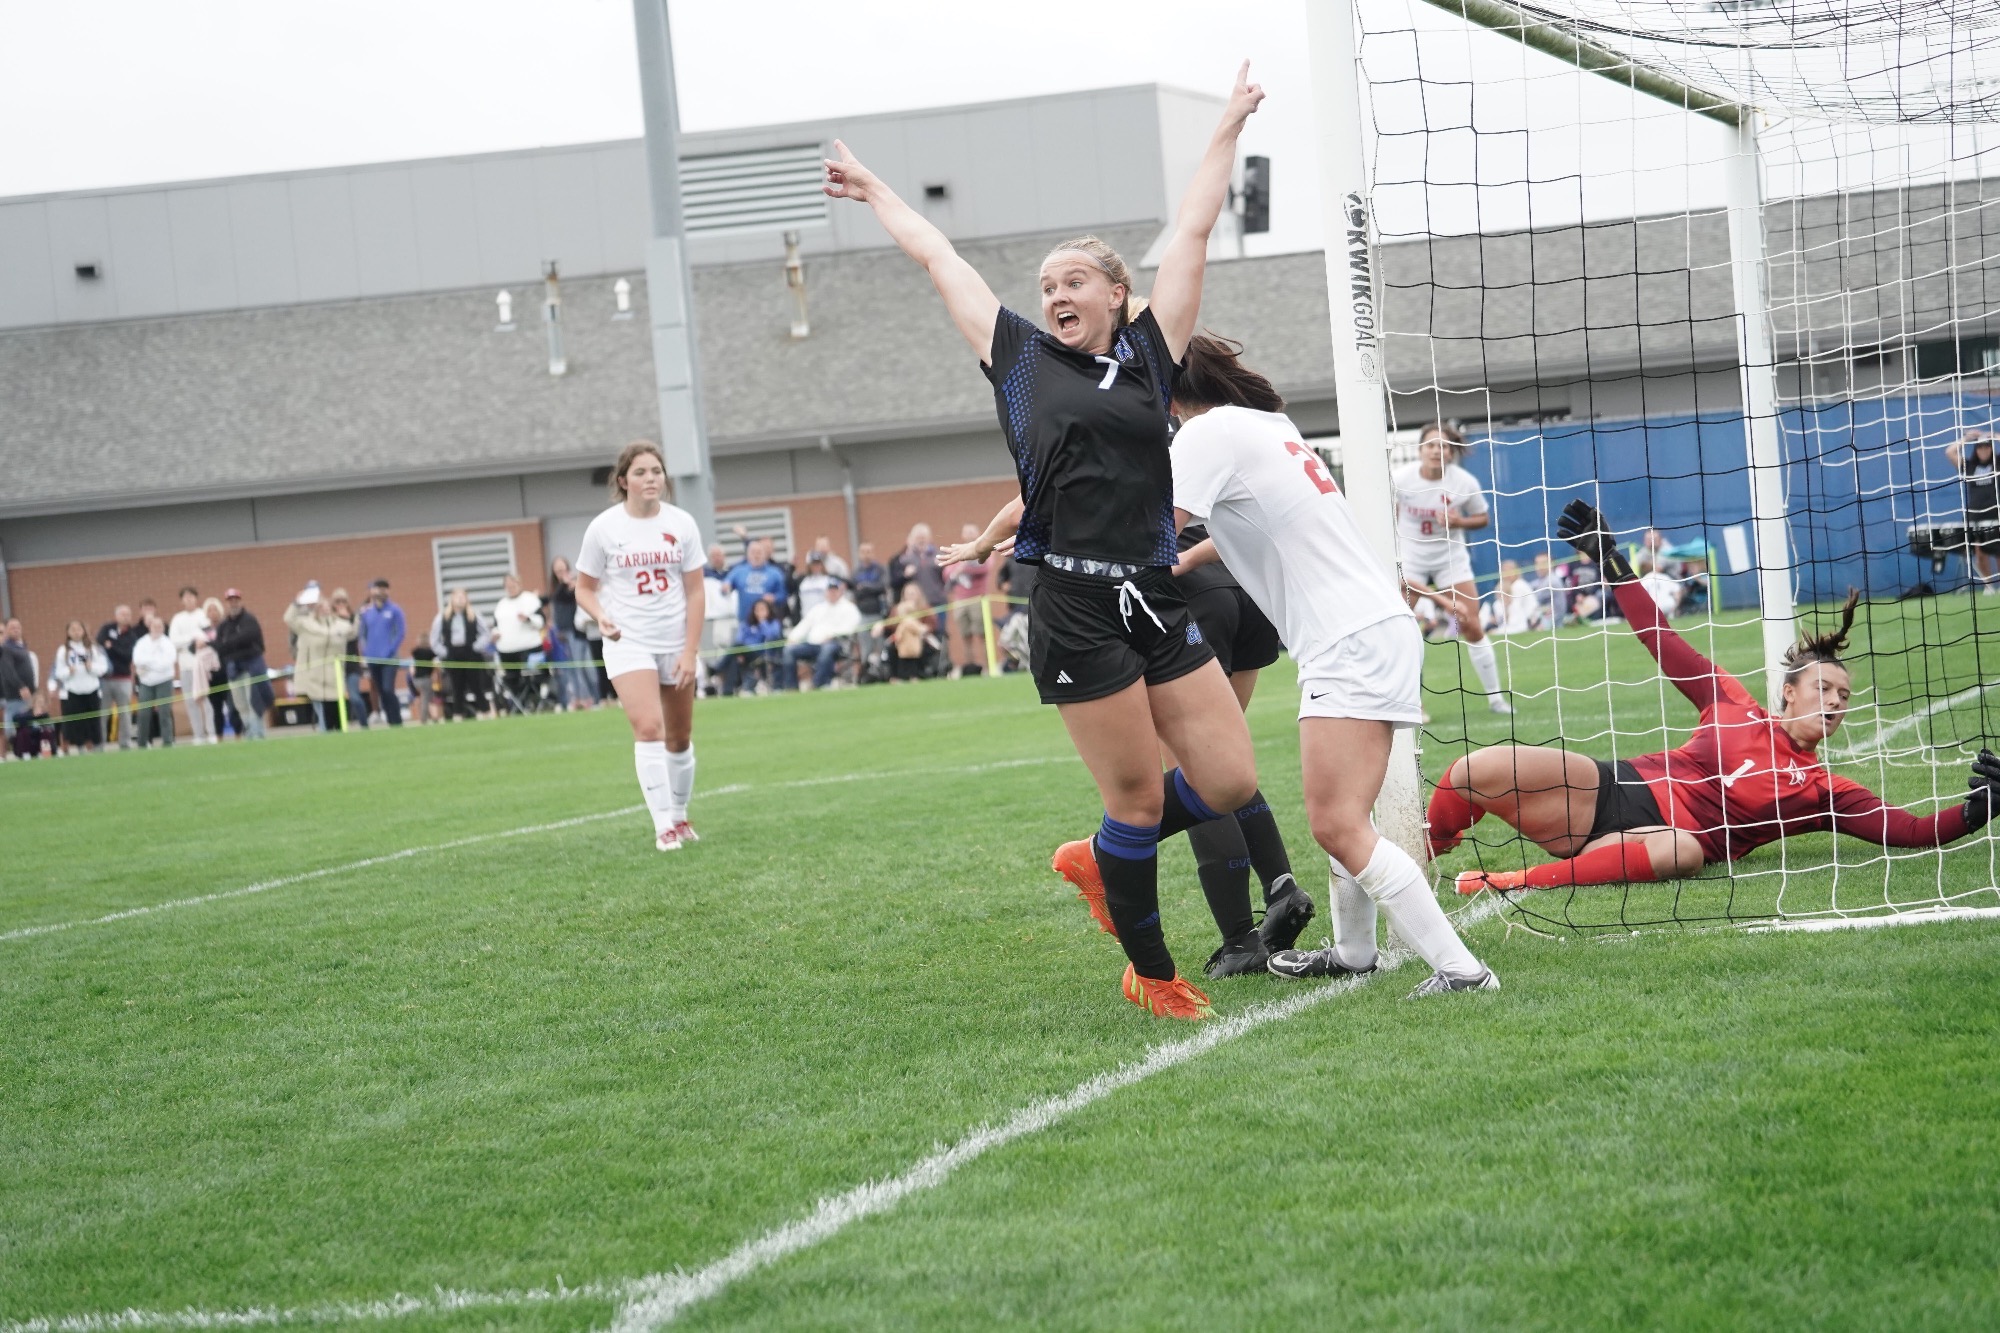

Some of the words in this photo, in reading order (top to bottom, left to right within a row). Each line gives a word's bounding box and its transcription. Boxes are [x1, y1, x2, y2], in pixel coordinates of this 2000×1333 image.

[1095, 355, 1120, 390] 7
[1284, 441, 1338, 495] 2
[1421, 520, 1433, 536] 8
[616, 549, 682, 568] CARDINALS
[635, 568, 669, 596] 25
